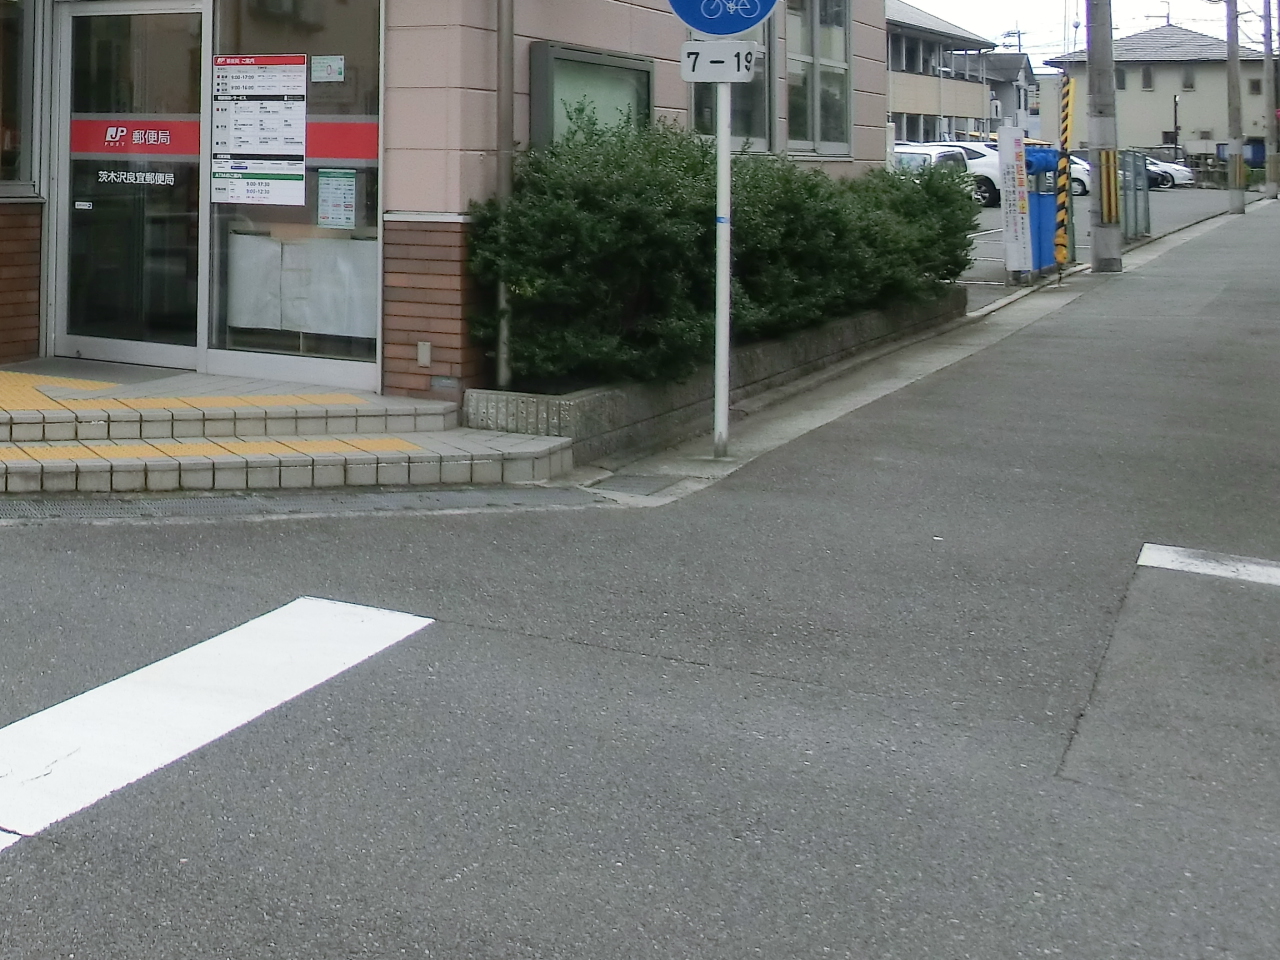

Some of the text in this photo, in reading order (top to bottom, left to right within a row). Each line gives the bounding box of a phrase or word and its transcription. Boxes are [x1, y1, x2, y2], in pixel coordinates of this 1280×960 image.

[131, 128, 171, 146] 郵便局
[98, 170, 175, 186] 茨木沢良宜郵便局
